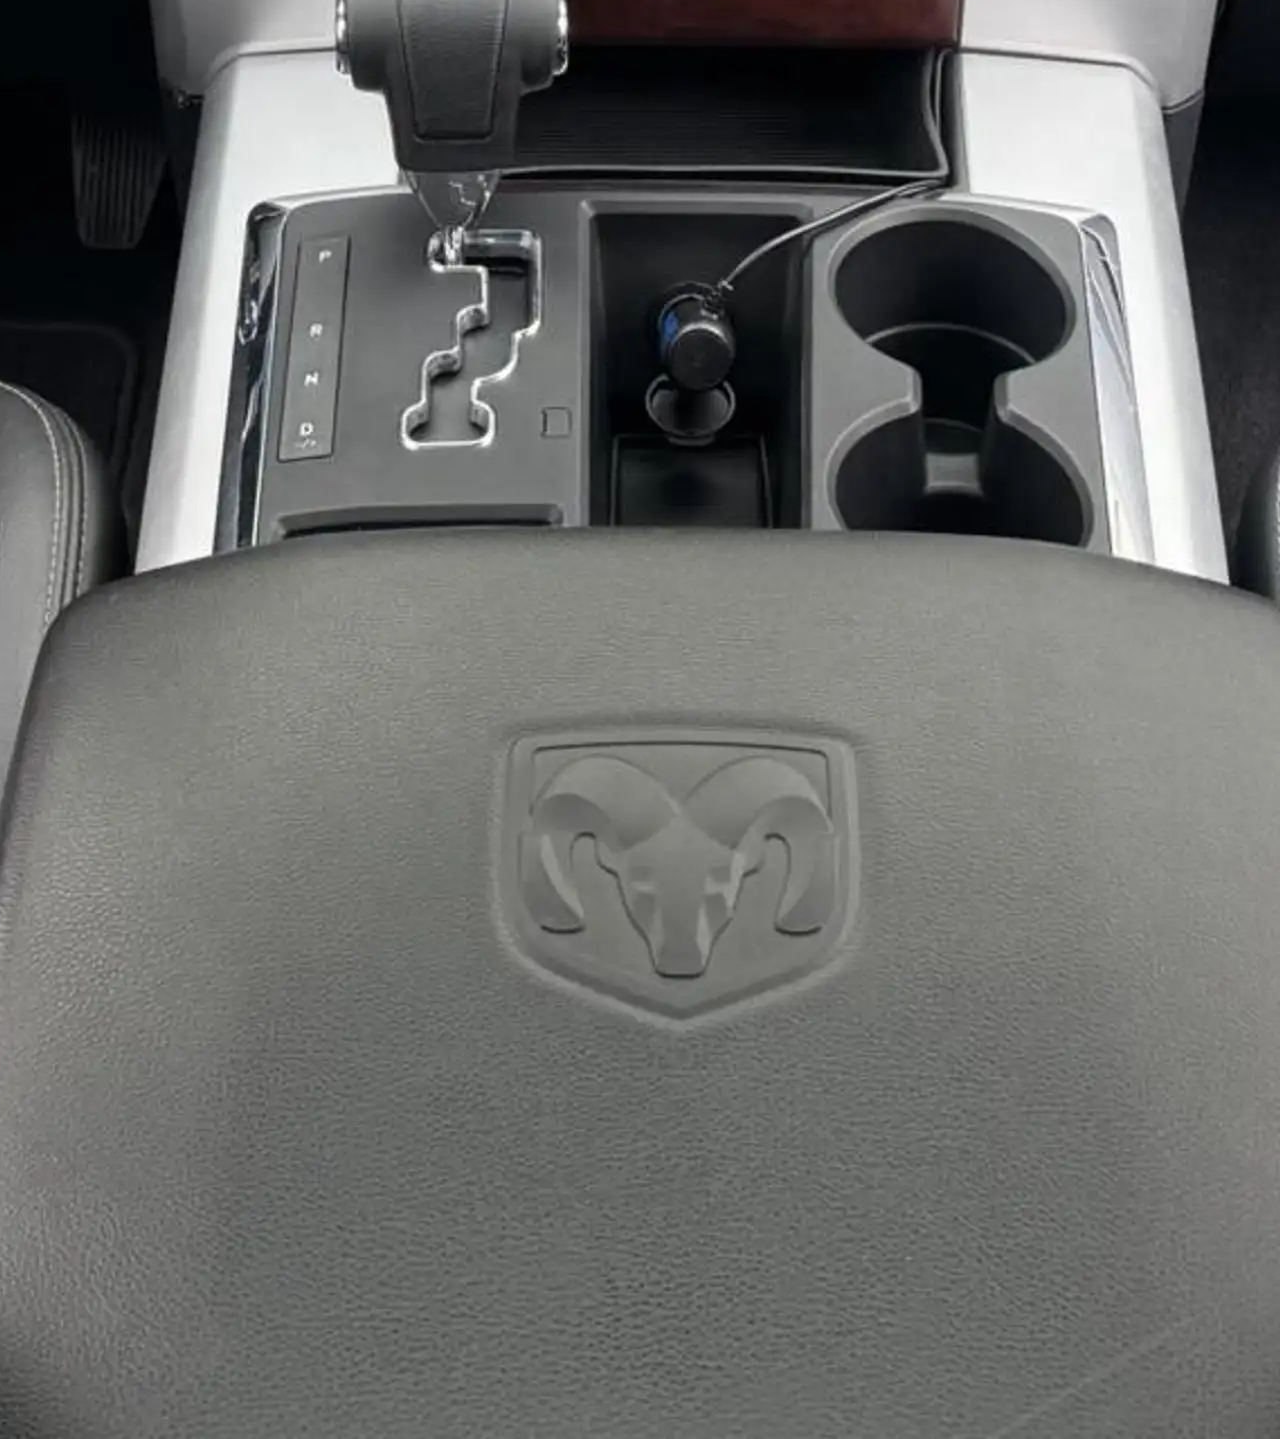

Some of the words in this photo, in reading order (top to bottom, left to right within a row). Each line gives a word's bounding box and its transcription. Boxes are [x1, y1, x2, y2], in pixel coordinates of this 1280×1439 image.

[319, 249, 333, 263] P
[309, 323, 323, 338] R
[303, 371, 319, 387] N
[299, 422, 314, 437] D
